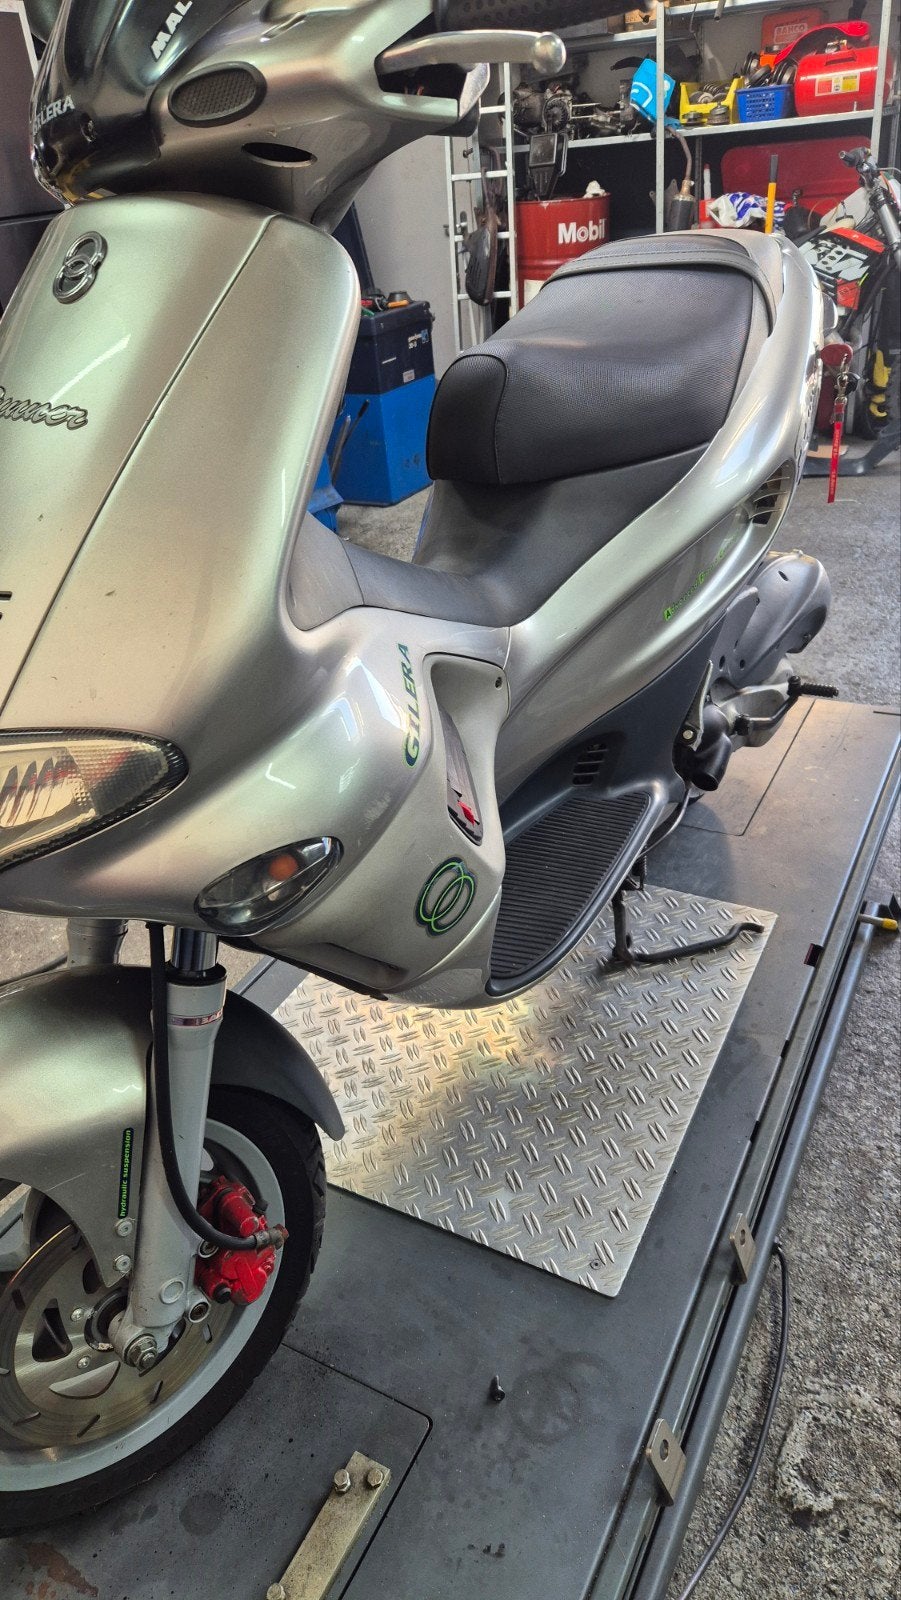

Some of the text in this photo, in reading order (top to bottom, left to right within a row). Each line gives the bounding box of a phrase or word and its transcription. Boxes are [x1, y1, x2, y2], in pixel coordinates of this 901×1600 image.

[558, 218, 605, 245] Mobil
[397, 642, 420, 767] GILERA
[120, 1130, 131, 1217] hydraulic suspension
